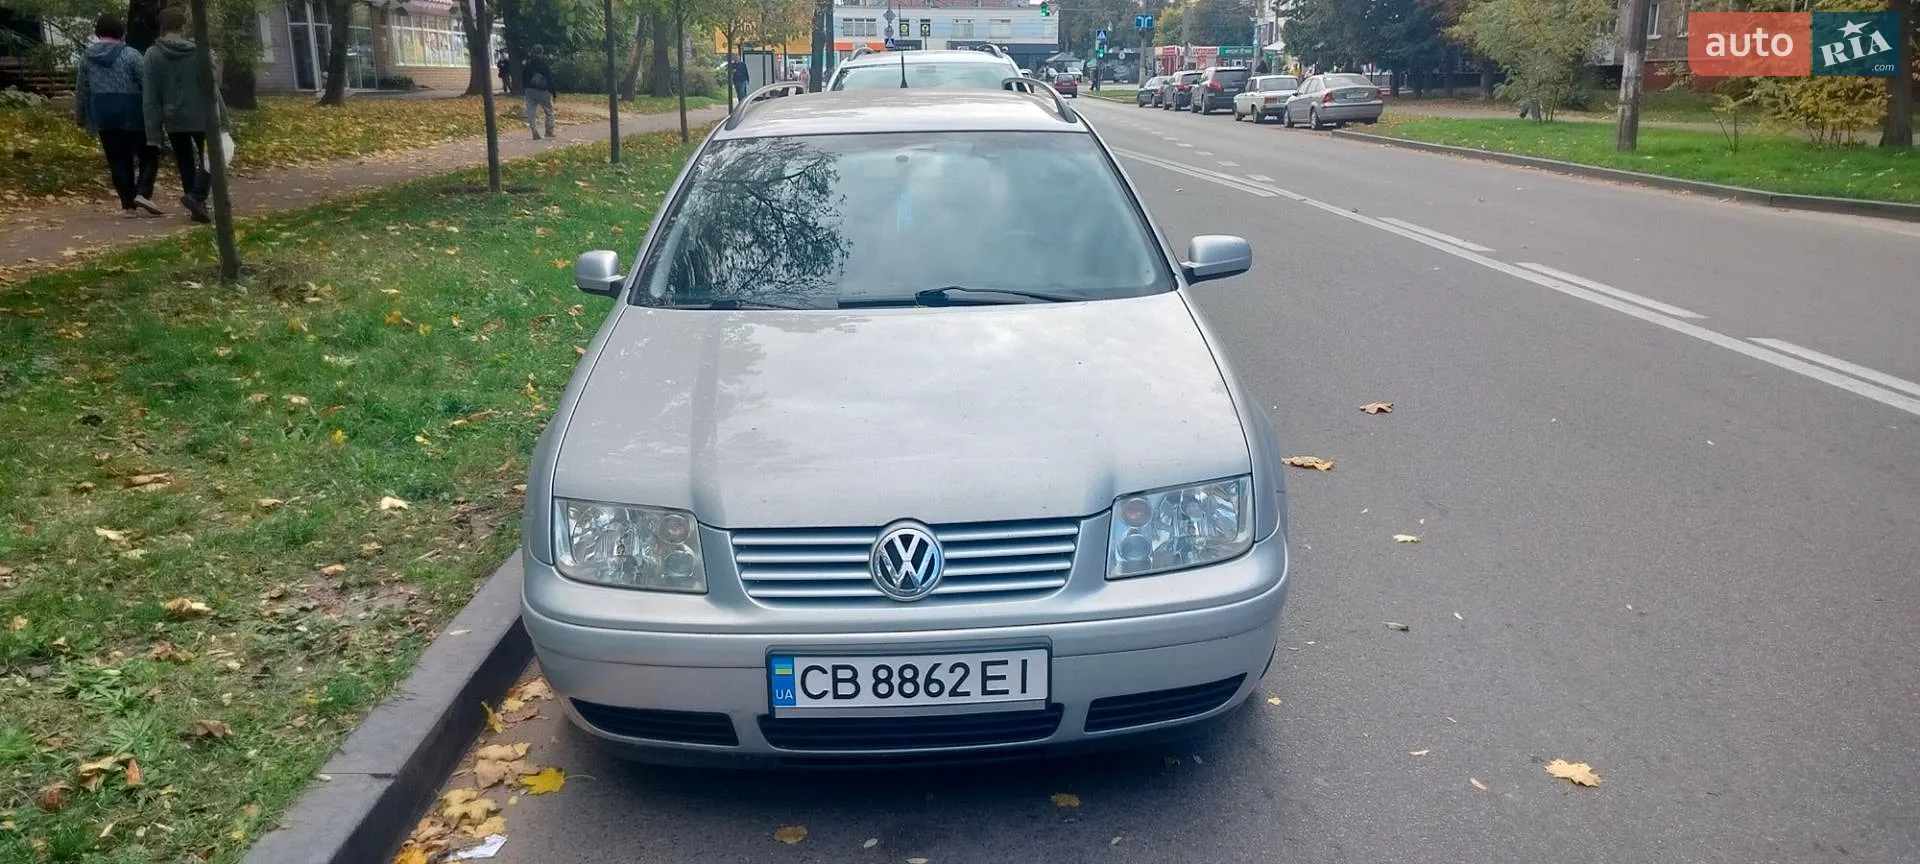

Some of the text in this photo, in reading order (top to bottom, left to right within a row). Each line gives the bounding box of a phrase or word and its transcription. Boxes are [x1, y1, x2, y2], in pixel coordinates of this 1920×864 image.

[800, 658, 1028, 700] CB 8862 EI
[775, 688, 794, 701] UA
